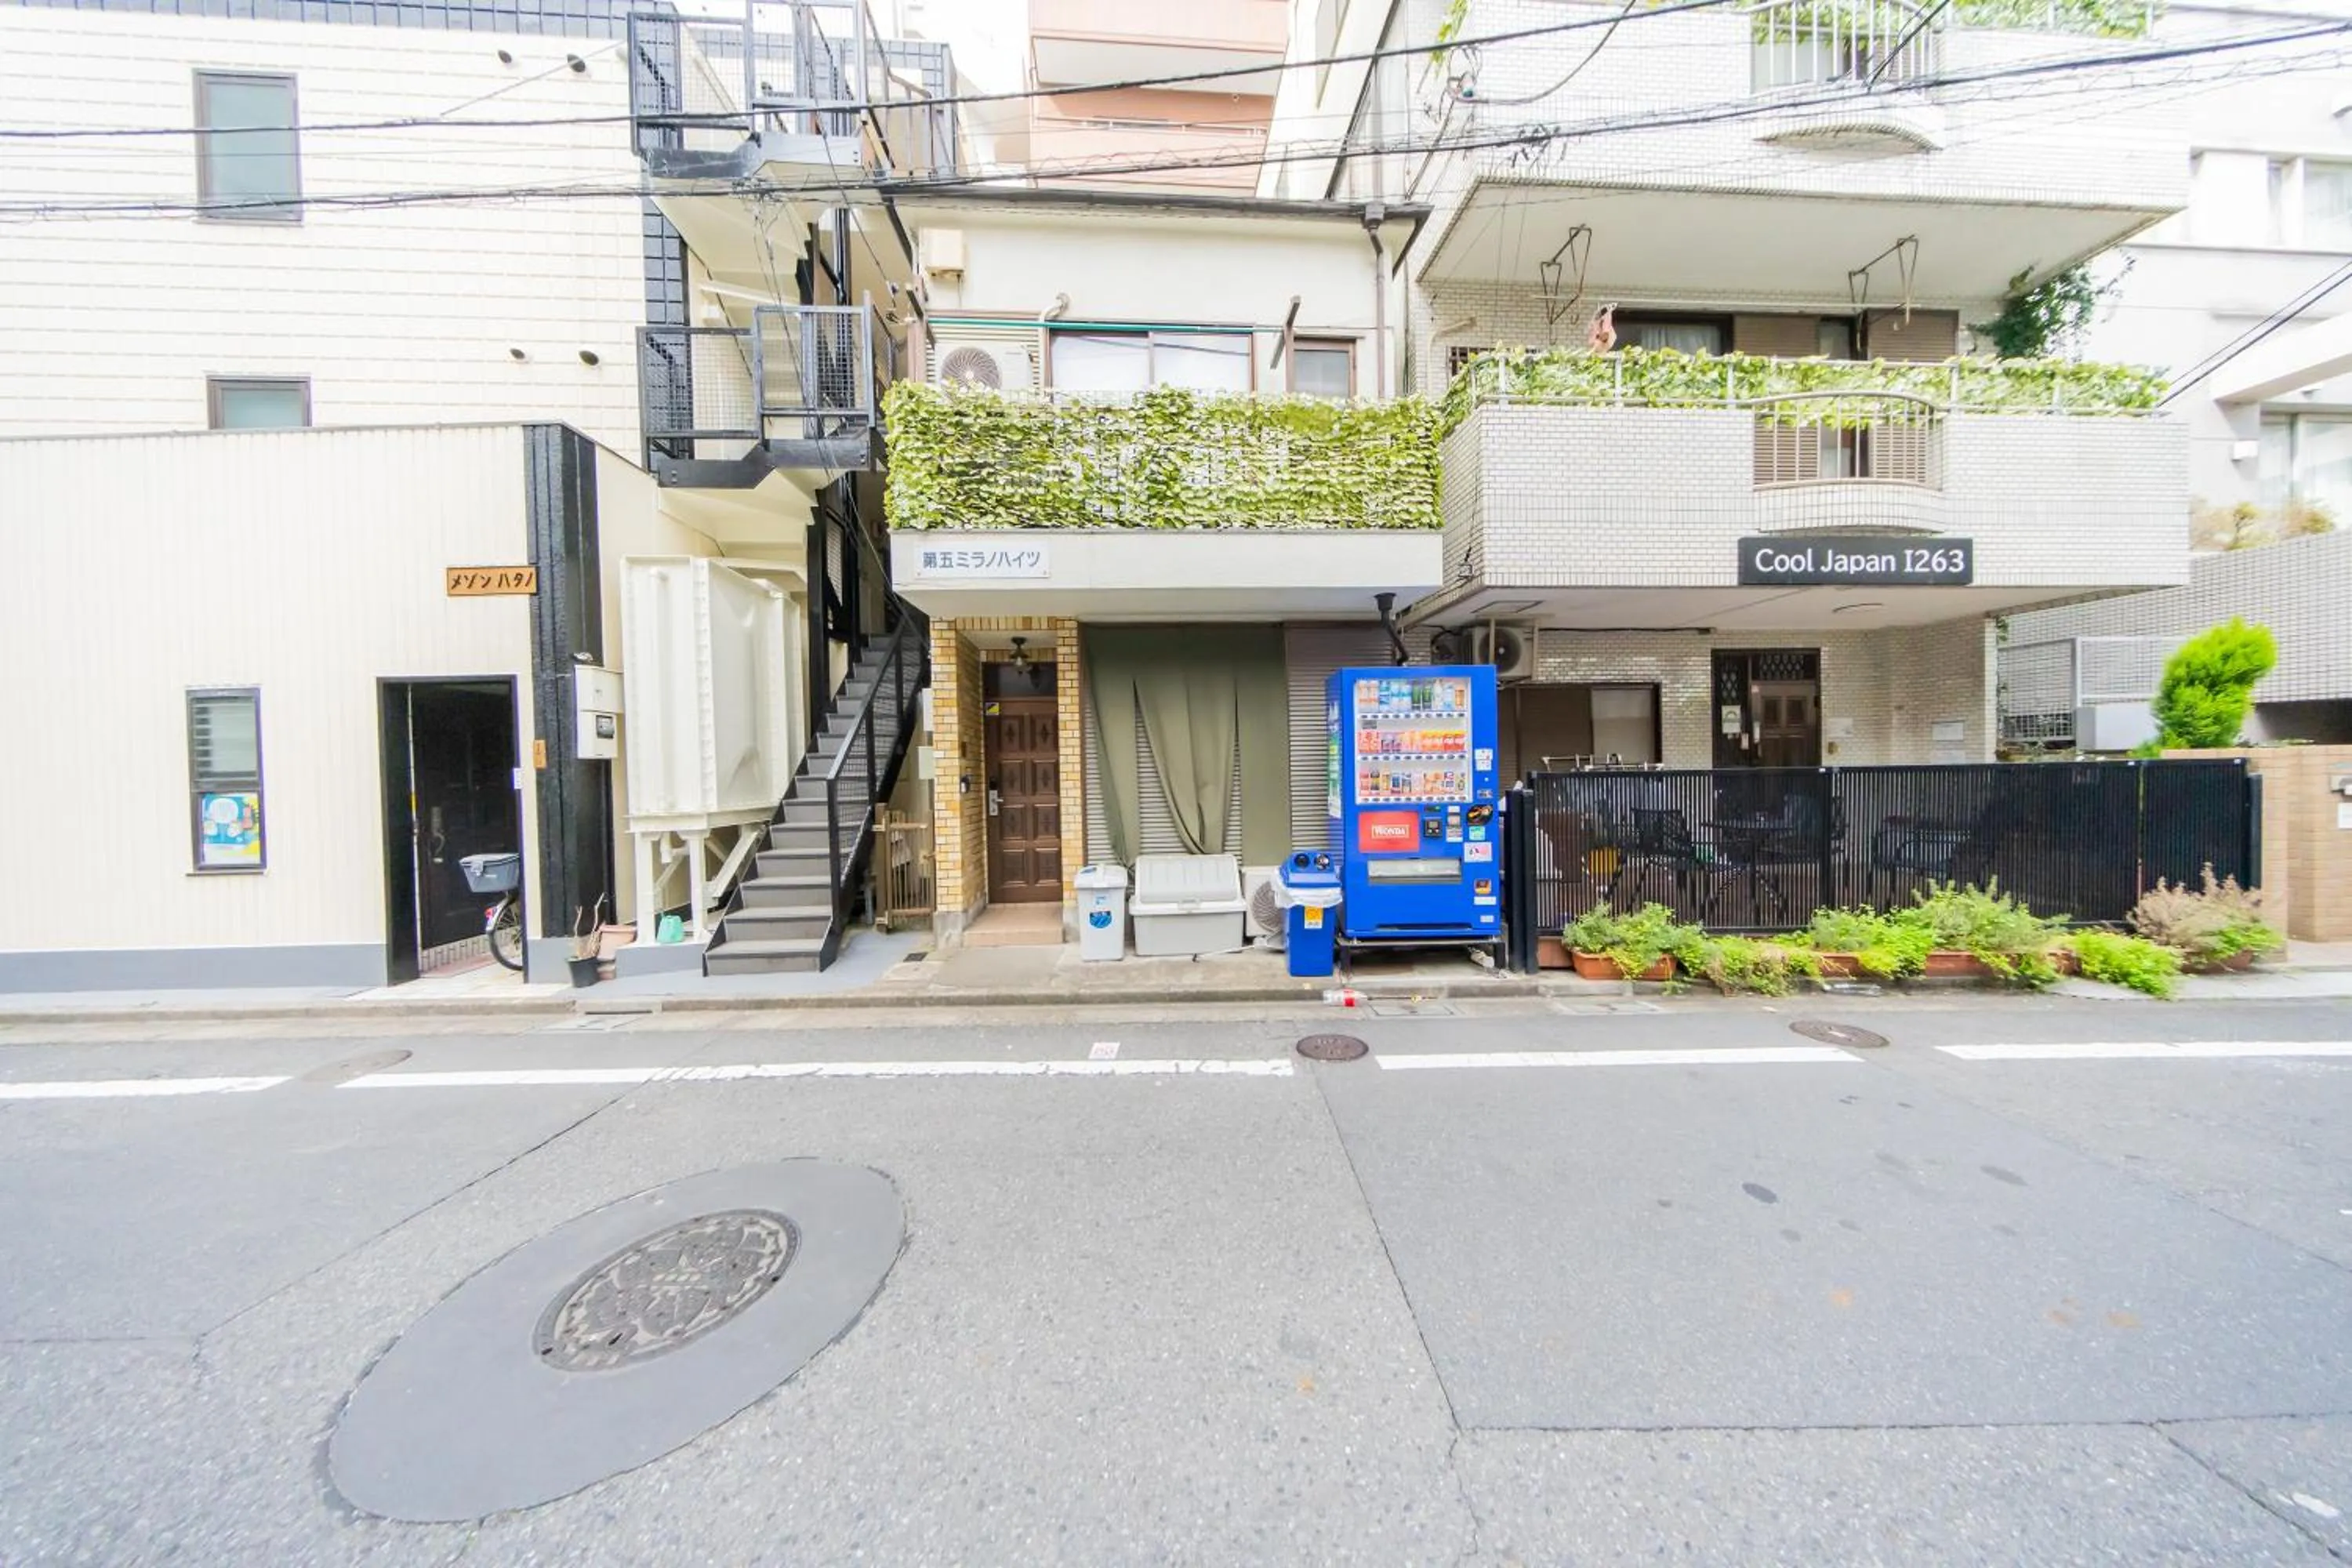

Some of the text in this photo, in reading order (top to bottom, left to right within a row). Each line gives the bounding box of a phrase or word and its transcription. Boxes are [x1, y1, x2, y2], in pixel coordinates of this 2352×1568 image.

[923, 551, 1040, 568] 第五ミラノハイツ
[1755, 549, 1814, 572] Cool
[1820, 550, 1896, 575] Japan
[498, 572, 533, 588] ハタノ
